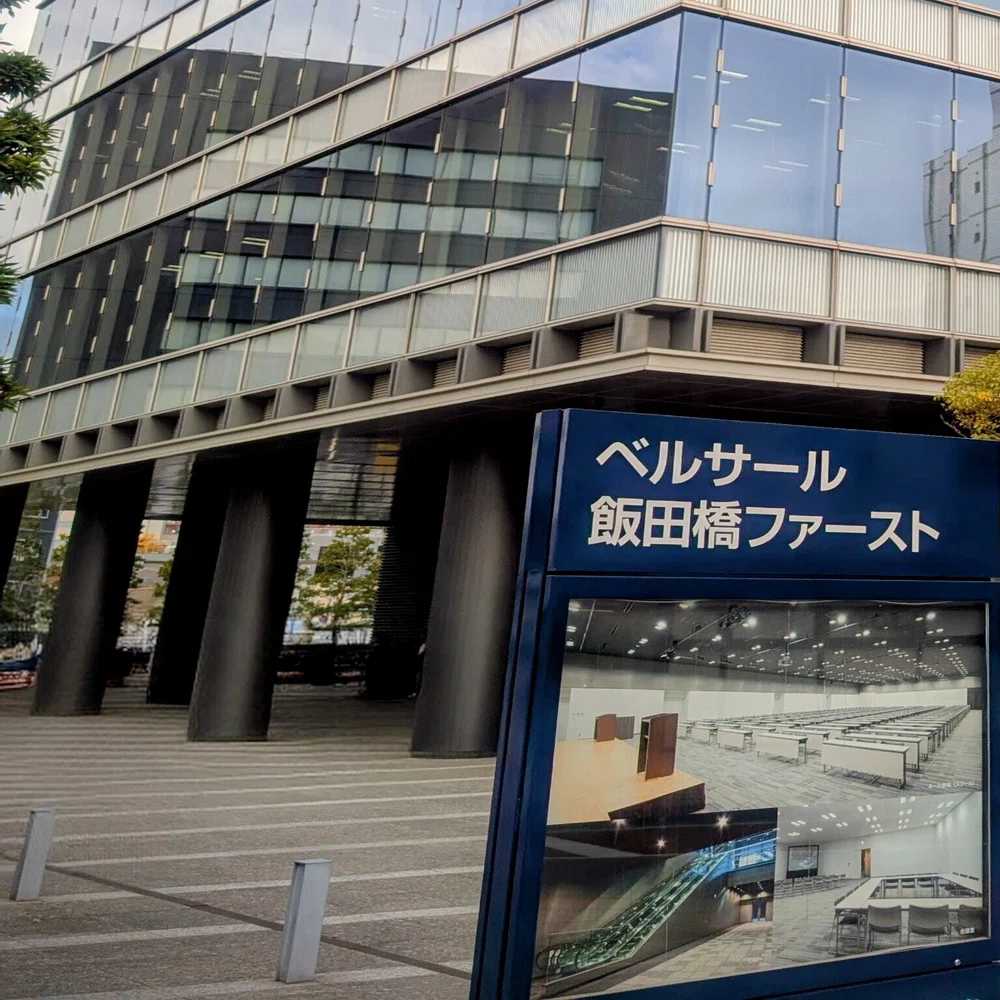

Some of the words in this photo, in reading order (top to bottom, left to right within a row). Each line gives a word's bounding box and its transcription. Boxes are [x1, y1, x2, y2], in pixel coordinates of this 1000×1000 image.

[596, 437, 847, 492] ベルサール
[587, 495, 940, 552] 飯田橋ファースト
